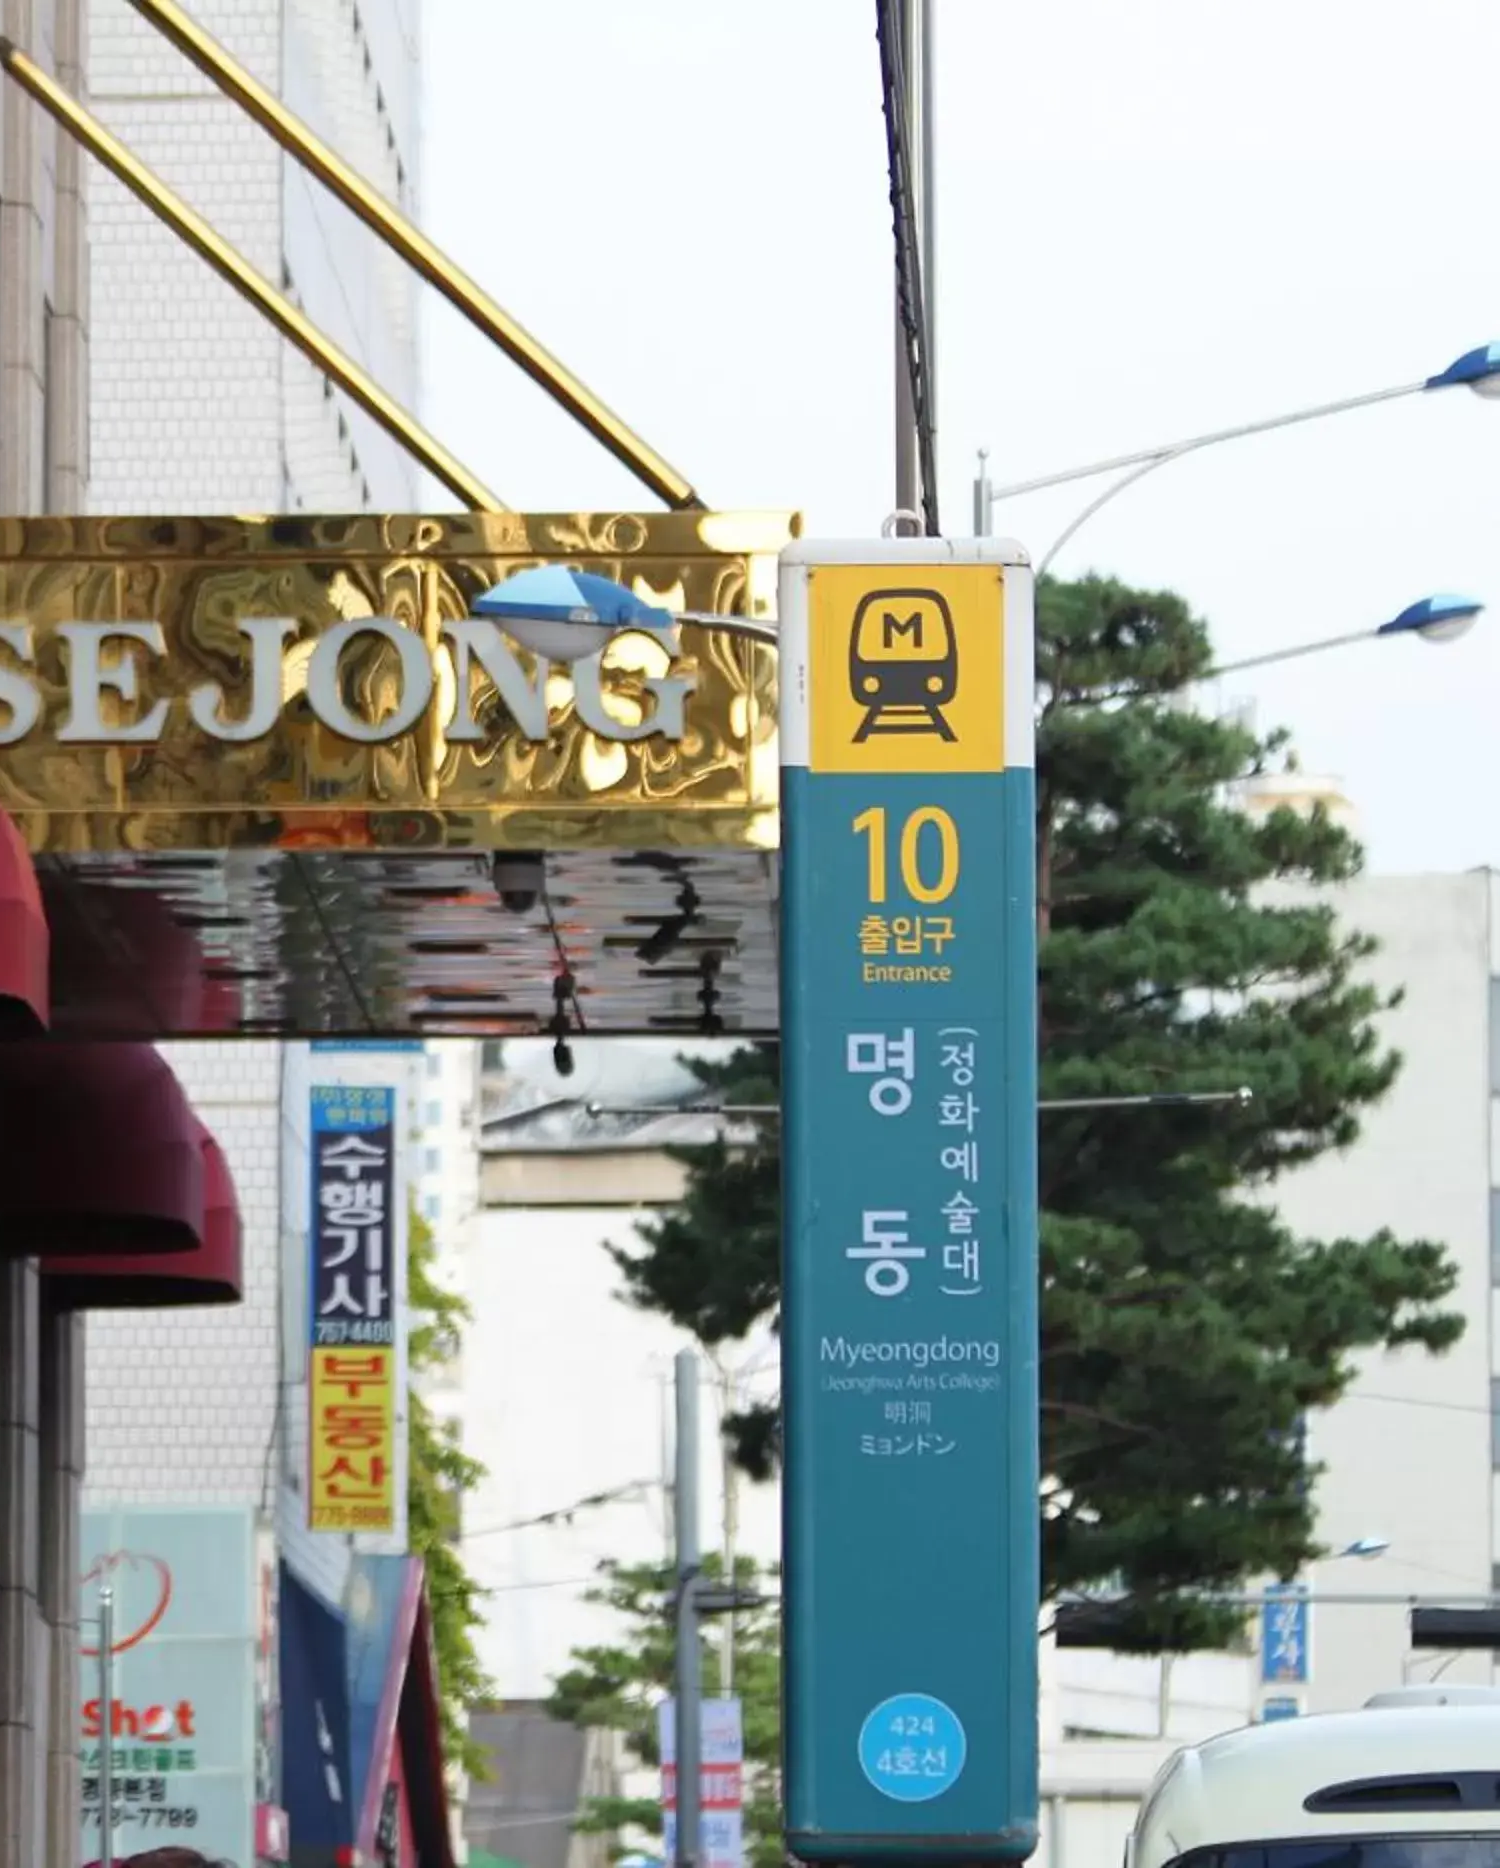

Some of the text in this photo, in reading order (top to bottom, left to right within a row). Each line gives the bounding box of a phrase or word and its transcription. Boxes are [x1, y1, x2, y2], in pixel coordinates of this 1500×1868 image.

[883, 612, 922, 648] M
[852, 805, 960, 904] 10
[857, 915, 955, 954] 출입구
[863, 962, 951, 983] Entrance
[846, 1027, 926, 1297] 명동
[937, 1027, 982, 1296] (정화예술대)
[320, 1134, 388, 1318] 수행기사
[820, 1334, 1000, 1369] Myeongdong
[906, 1374, 936, 1391] Arts
[319, 1356, 390, 1499] 부동산
[884, 1400, 932, 1425] 明洞
[860, 1433, 958, 1456] ミョンドン
[890, 1715, 935, 1737] 424
[876, 1745, 947, 1777] 4호선
